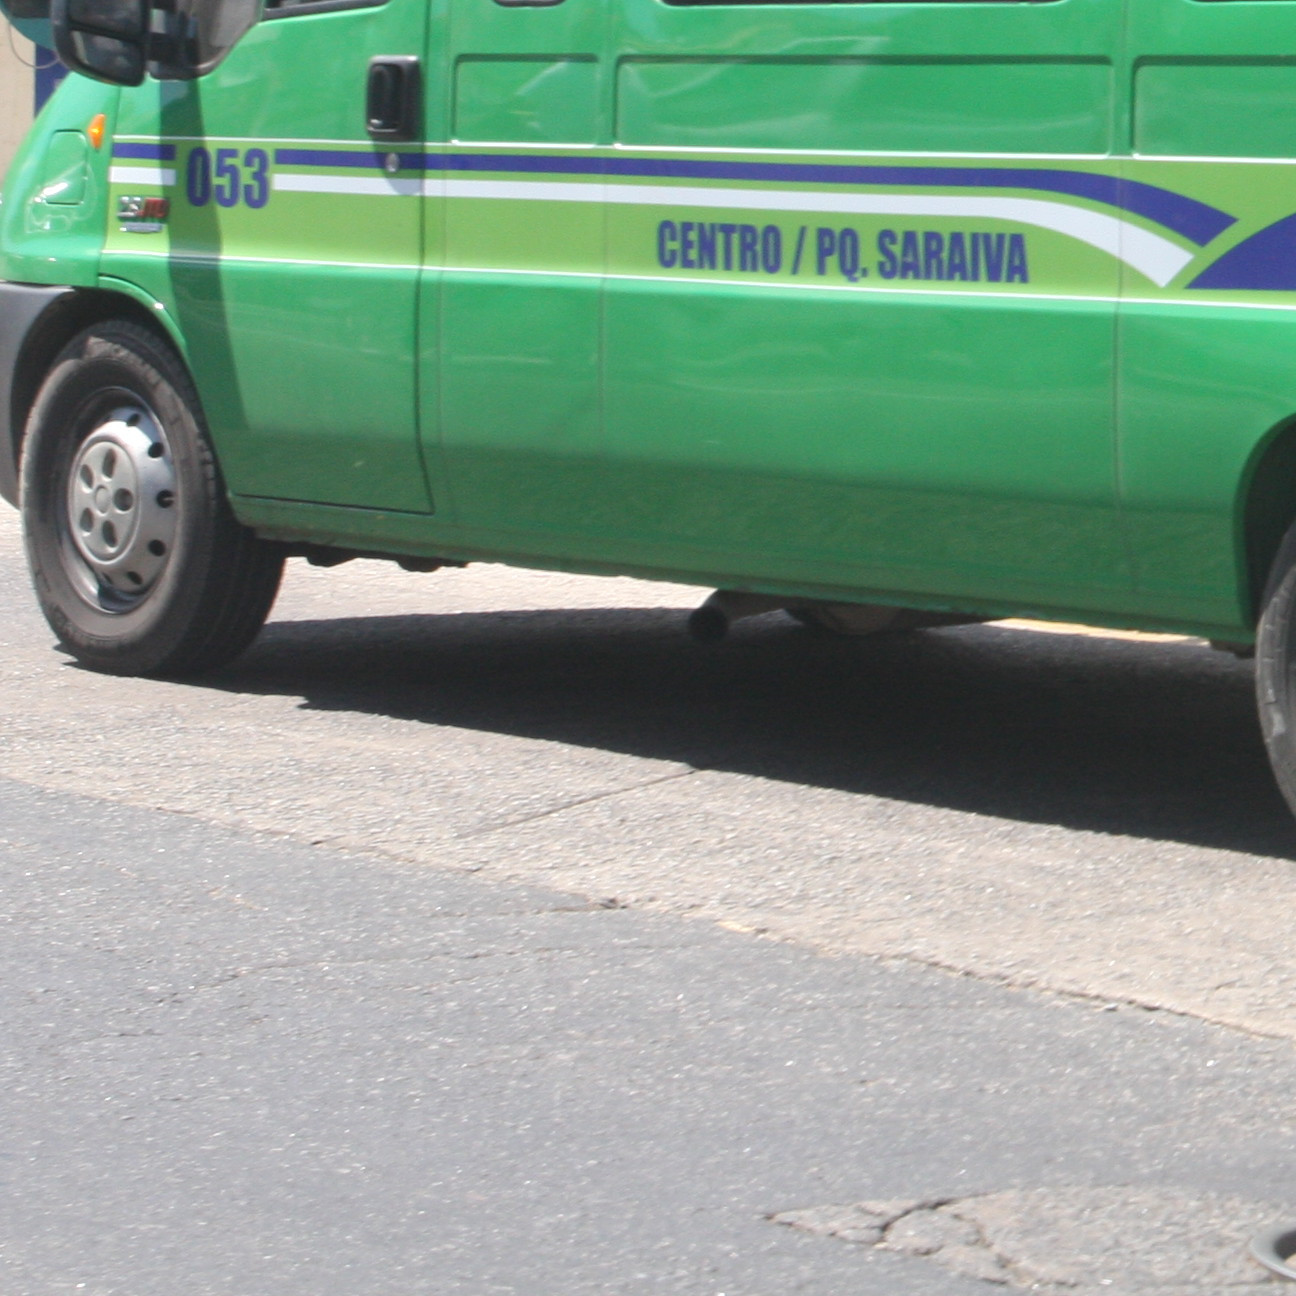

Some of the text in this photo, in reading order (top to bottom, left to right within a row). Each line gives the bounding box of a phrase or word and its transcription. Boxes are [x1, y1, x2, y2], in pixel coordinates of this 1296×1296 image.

[186, 146, 270, 209] 053
[657, 219, 1030, 283] CENTRO / PQ. SARAIVA
